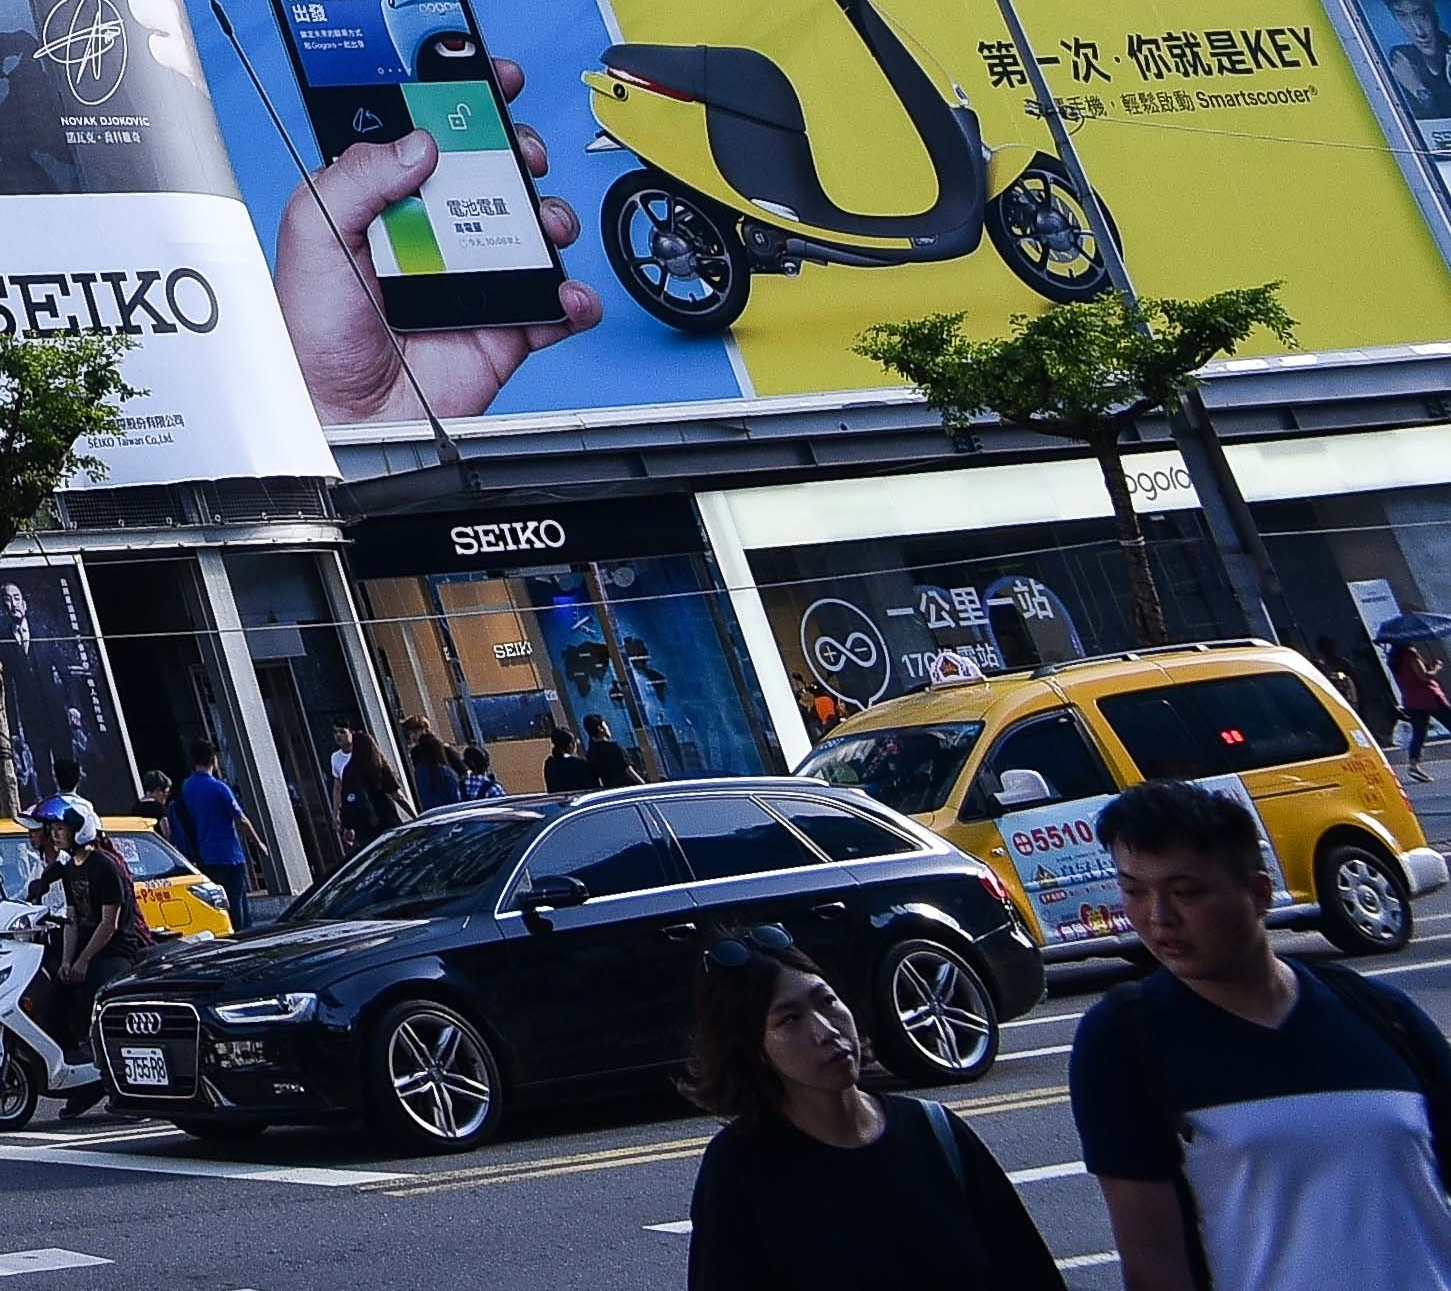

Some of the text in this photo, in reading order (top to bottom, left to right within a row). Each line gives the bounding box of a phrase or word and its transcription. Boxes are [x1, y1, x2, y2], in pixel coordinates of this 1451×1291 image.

[292, 4, 328, 23] 出發
[60, 116, 150, 127] NOVAK DJOKOVIC
[447, 198, 510, 217] 電池電量
[88, 437, 115, 448] SEIKO
[117, 437, 144, 446] Taiwan
[1125, 466, 1191, 501] ogoro
[450, 519, 566, 556] SEIKO
[886, 578, 1054, 629] 一公里一站
